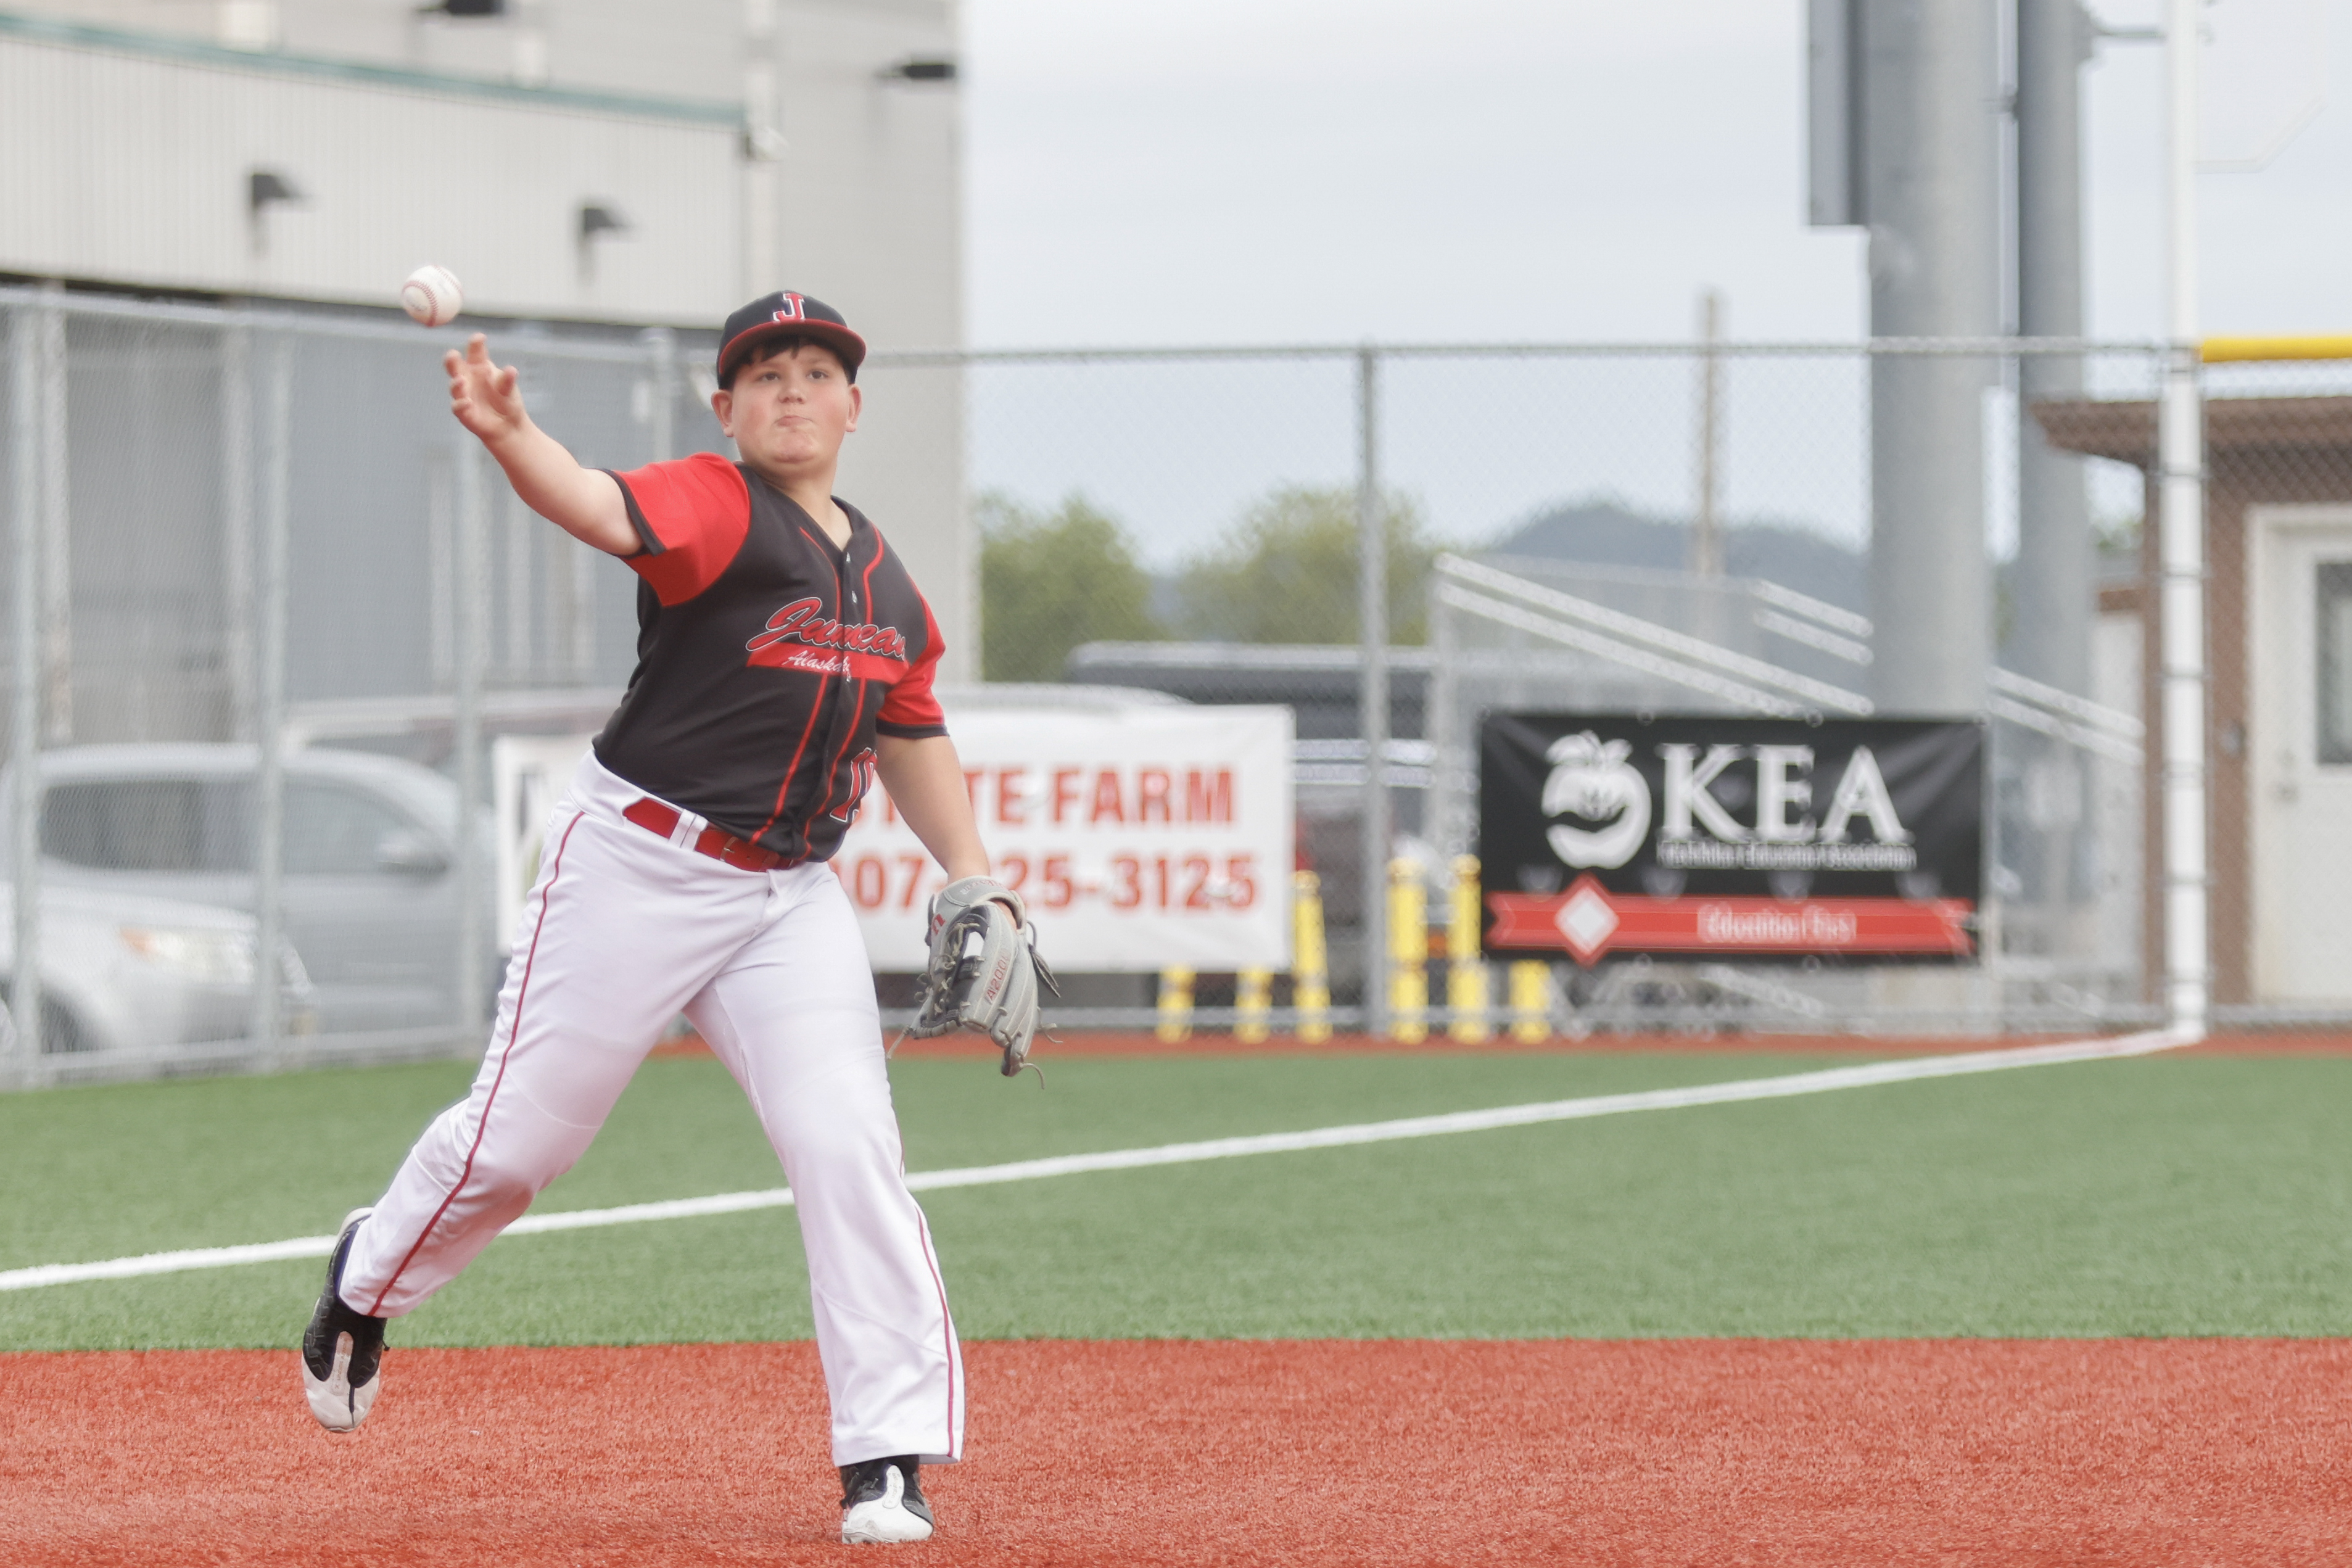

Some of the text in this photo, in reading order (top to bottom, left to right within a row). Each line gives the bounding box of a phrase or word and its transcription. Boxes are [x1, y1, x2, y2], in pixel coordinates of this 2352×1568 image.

[772, 292, 806, 322] J
[1050, 769, 1234, 823] FARM
[1657, 743, 1913, 843] KEA
